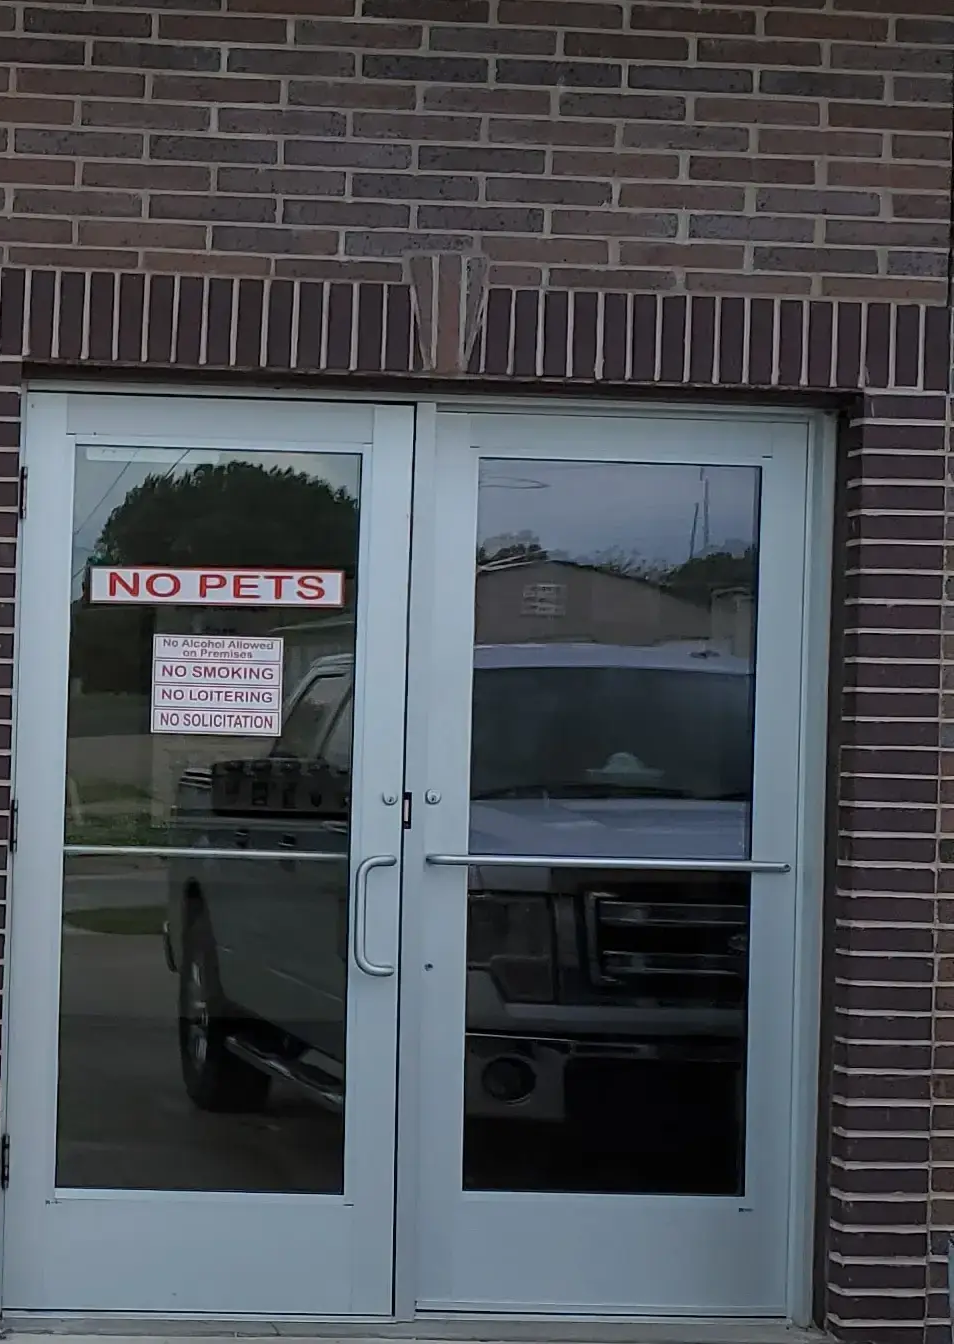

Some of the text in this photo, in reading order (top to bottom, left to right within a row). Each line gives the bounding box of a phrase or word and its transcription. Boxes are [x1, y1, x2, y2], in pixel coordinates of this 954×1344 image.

[109, 571, 326, 600] NO PETS
[162, 638, 274, 651] No Alcohol Allowed
[182, 649, 253, 659] on Premises
[161, 665, 274, 680] NO SMOKING
[161, 689, 273, 703] NO LOITERING
[160, 713, 273, 729] NO SOLICITATION
